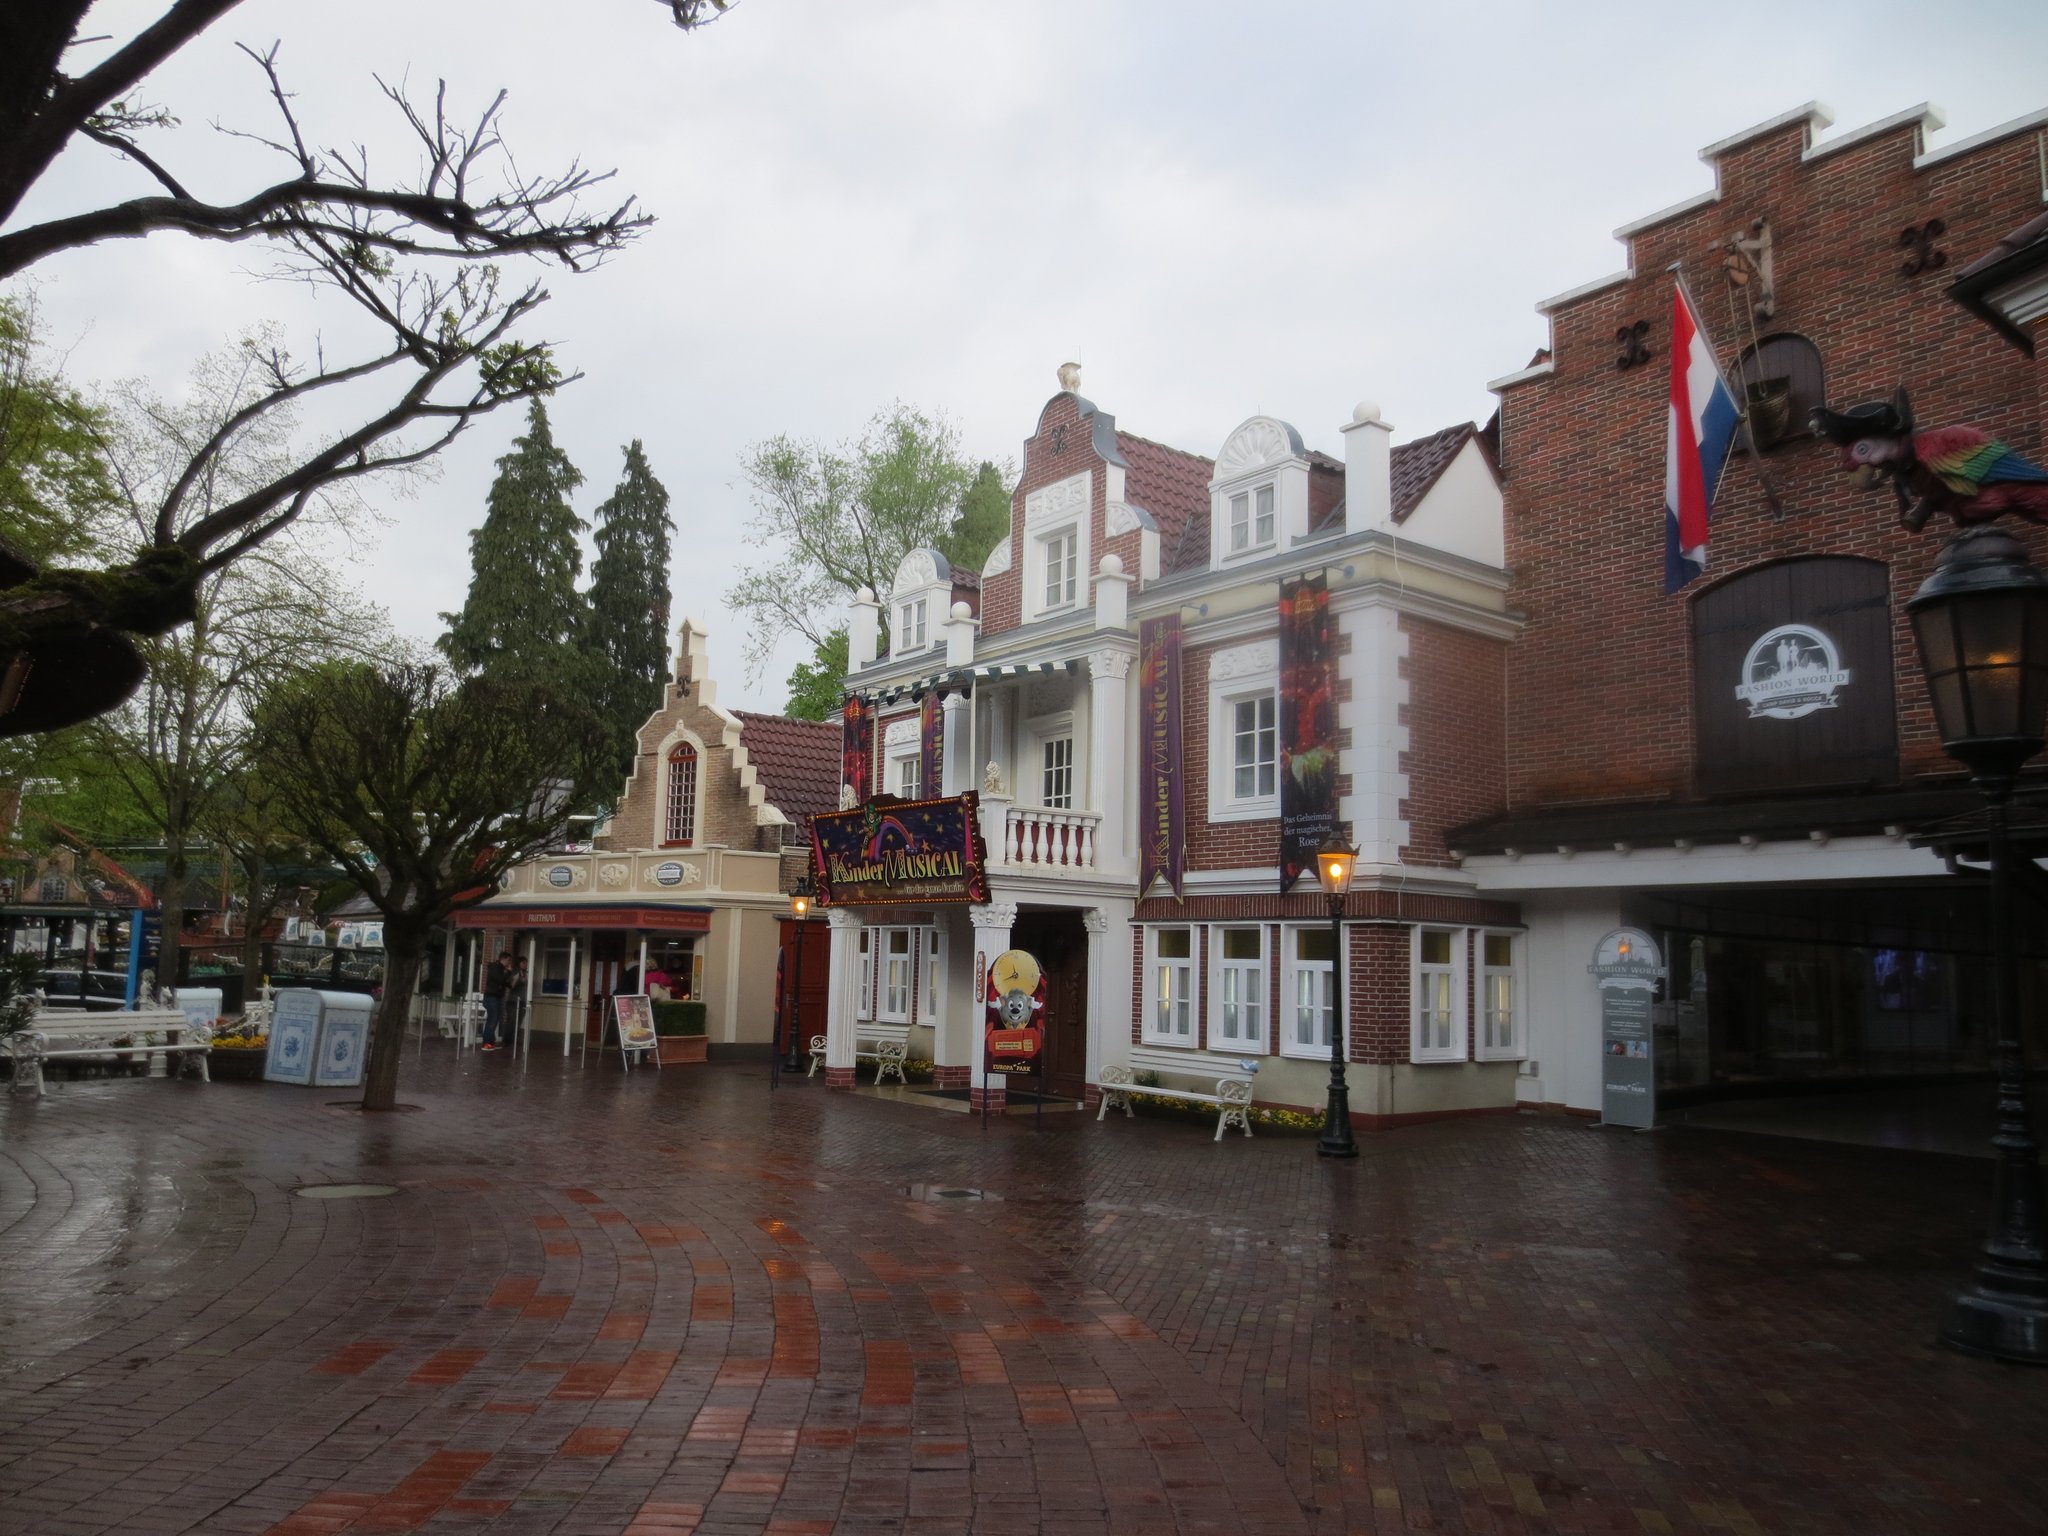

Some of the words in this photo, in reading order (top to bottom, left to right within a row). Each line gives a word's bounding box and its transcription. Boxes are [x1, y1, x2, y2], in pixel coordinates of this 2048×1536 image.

[1739, 679, 1792, 696] FASHION
[1798, 673, 1846, 686] WORLD
[1283, 816, 1296, 824] Das
[1284, 827, 1295, 836] der
[1298, 836, 1320, 847] Rose
[528, 913, 556, 922] FRIETHUYS
[1588, 965, 1627, 973] FASHION
[1631, 966, 1665, 976] WORLD
